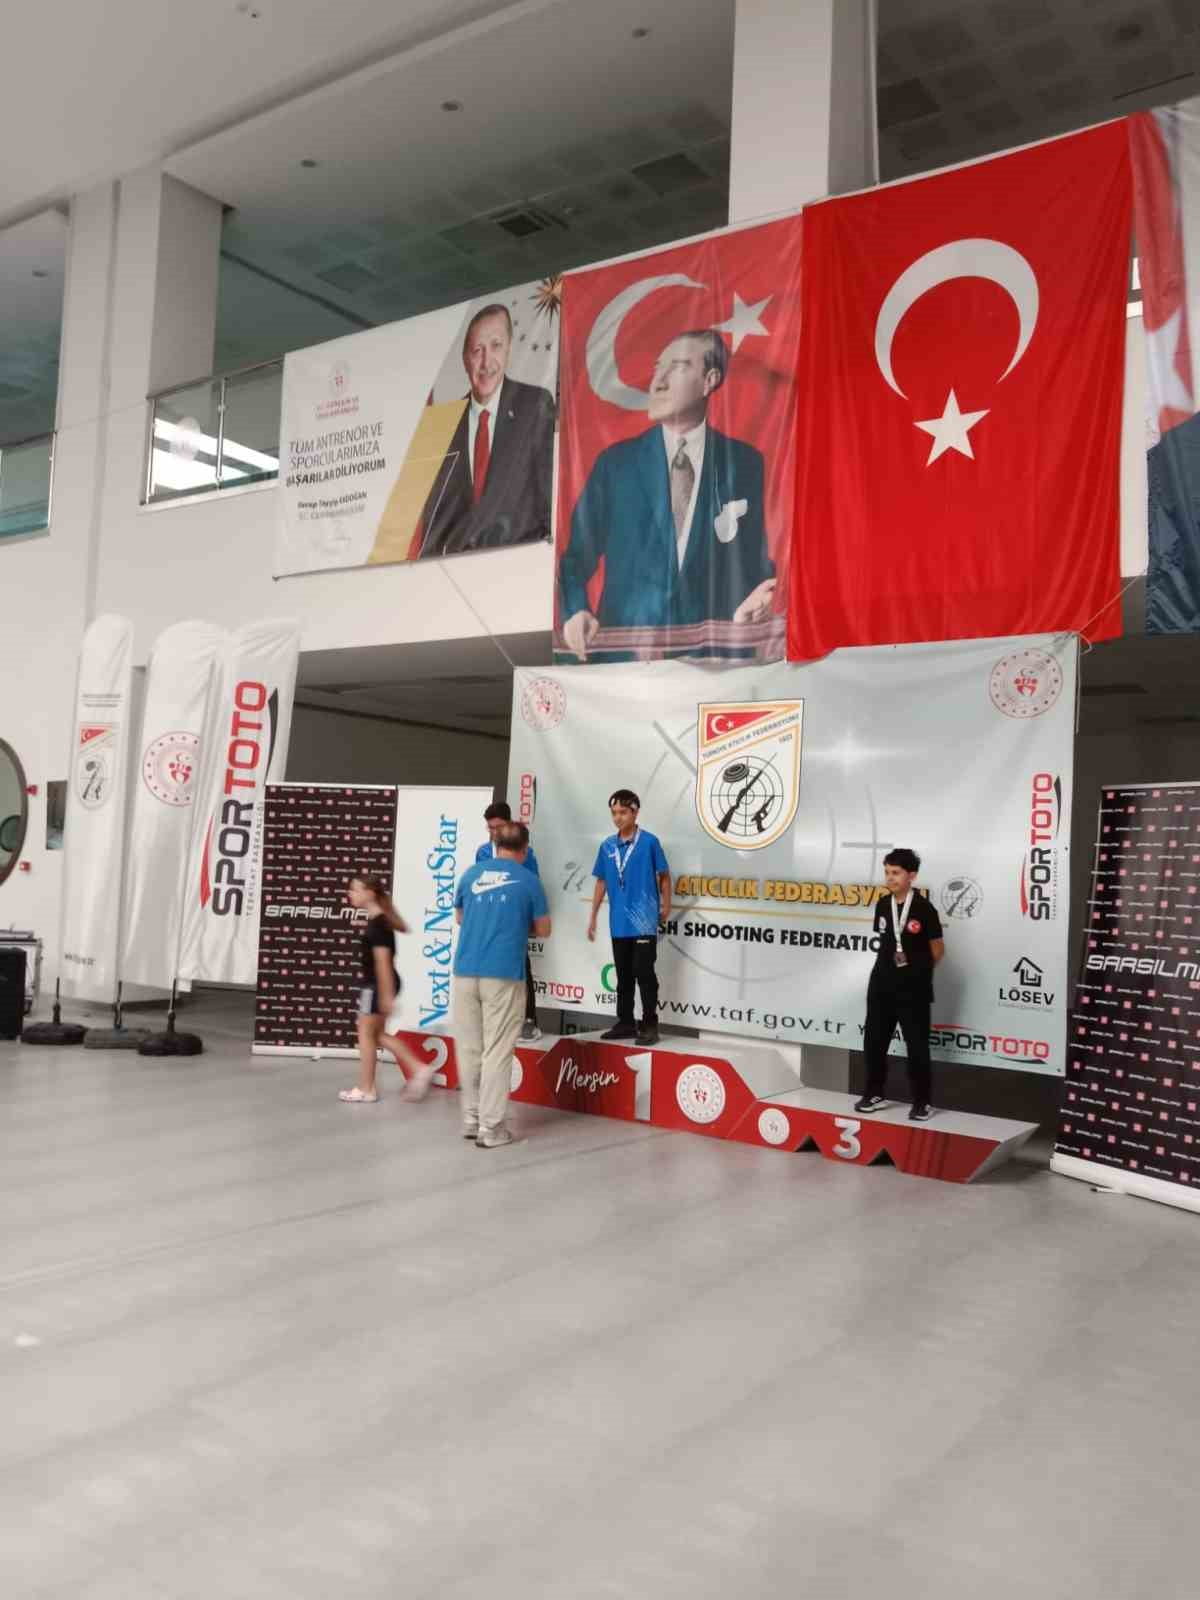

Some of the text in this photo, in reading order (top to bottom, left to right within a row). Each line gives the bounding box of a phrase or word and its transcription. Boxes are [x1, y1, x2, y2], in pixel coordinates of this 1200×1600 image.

[684, 922, 775, 943] SHOOTING
[780, 928, 881, 953] FEDERATIO
[555, 1056, 621, 1095] Mersin
[623, 1051, 652, 1121] 1
[832, 1116, 862, 1160] 3
